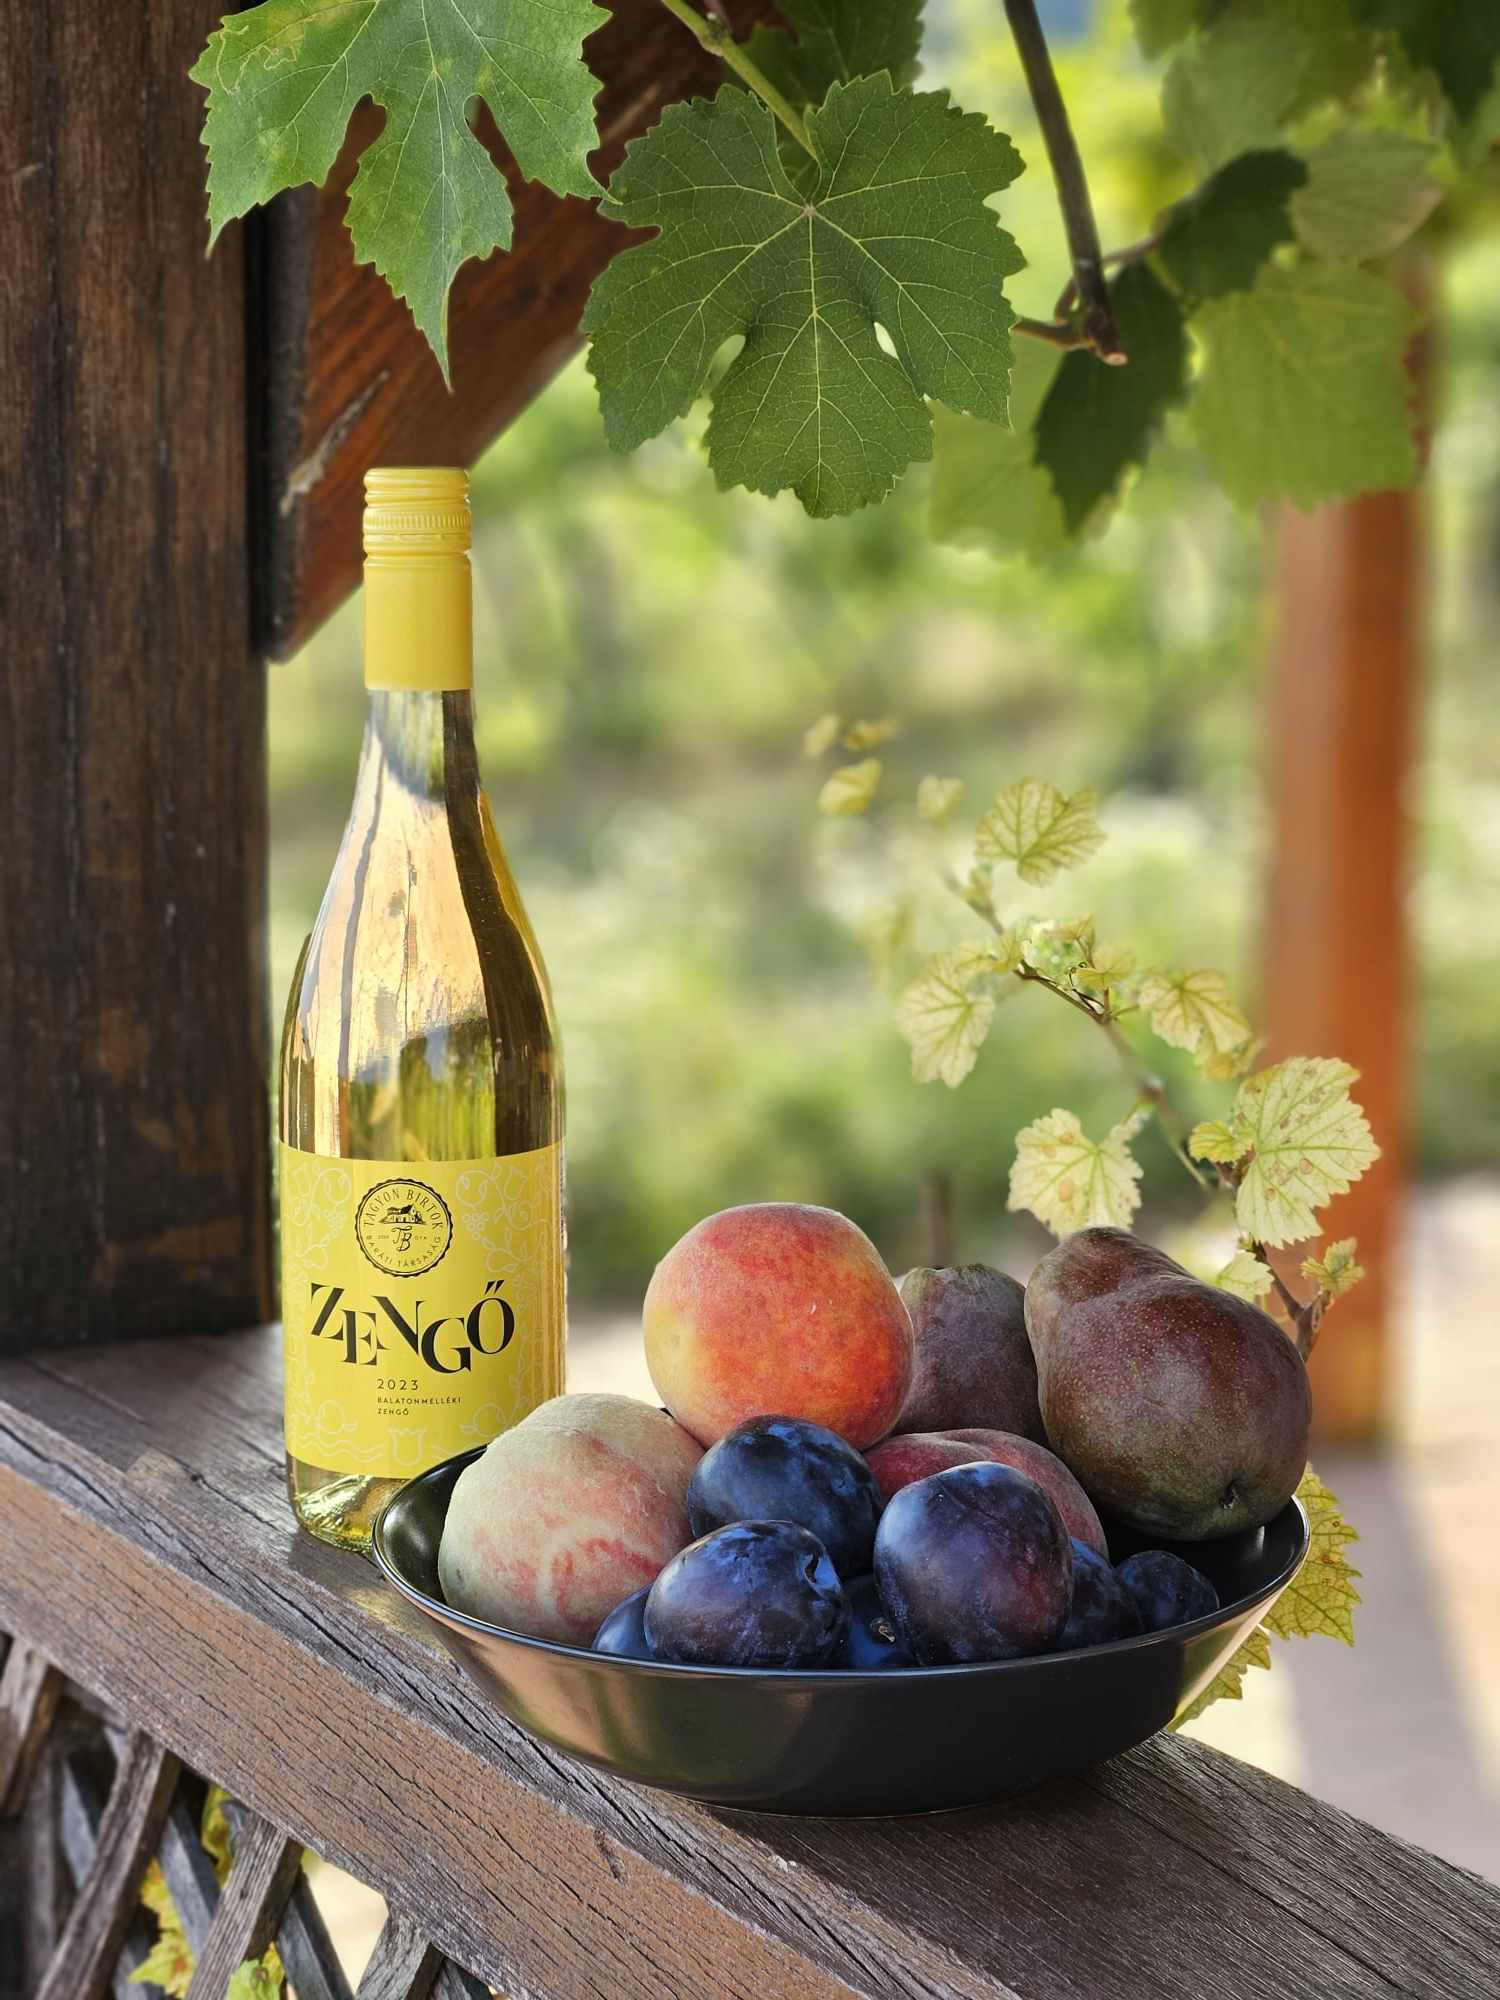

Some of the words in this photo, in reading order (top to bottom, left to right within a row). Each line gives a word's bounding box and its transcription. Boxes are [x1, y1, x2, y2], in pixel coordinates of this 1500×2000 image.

[363, 1188, 400, 1226] TAGYON
[407, 1188, 443, 1229] BIRTOK
[311, 1280, 515, 1373] ZENGŐ
[377, 1378, 418, 1391] 2023
[377, 1396, 461, 1405] BALATONMELLÉKI
